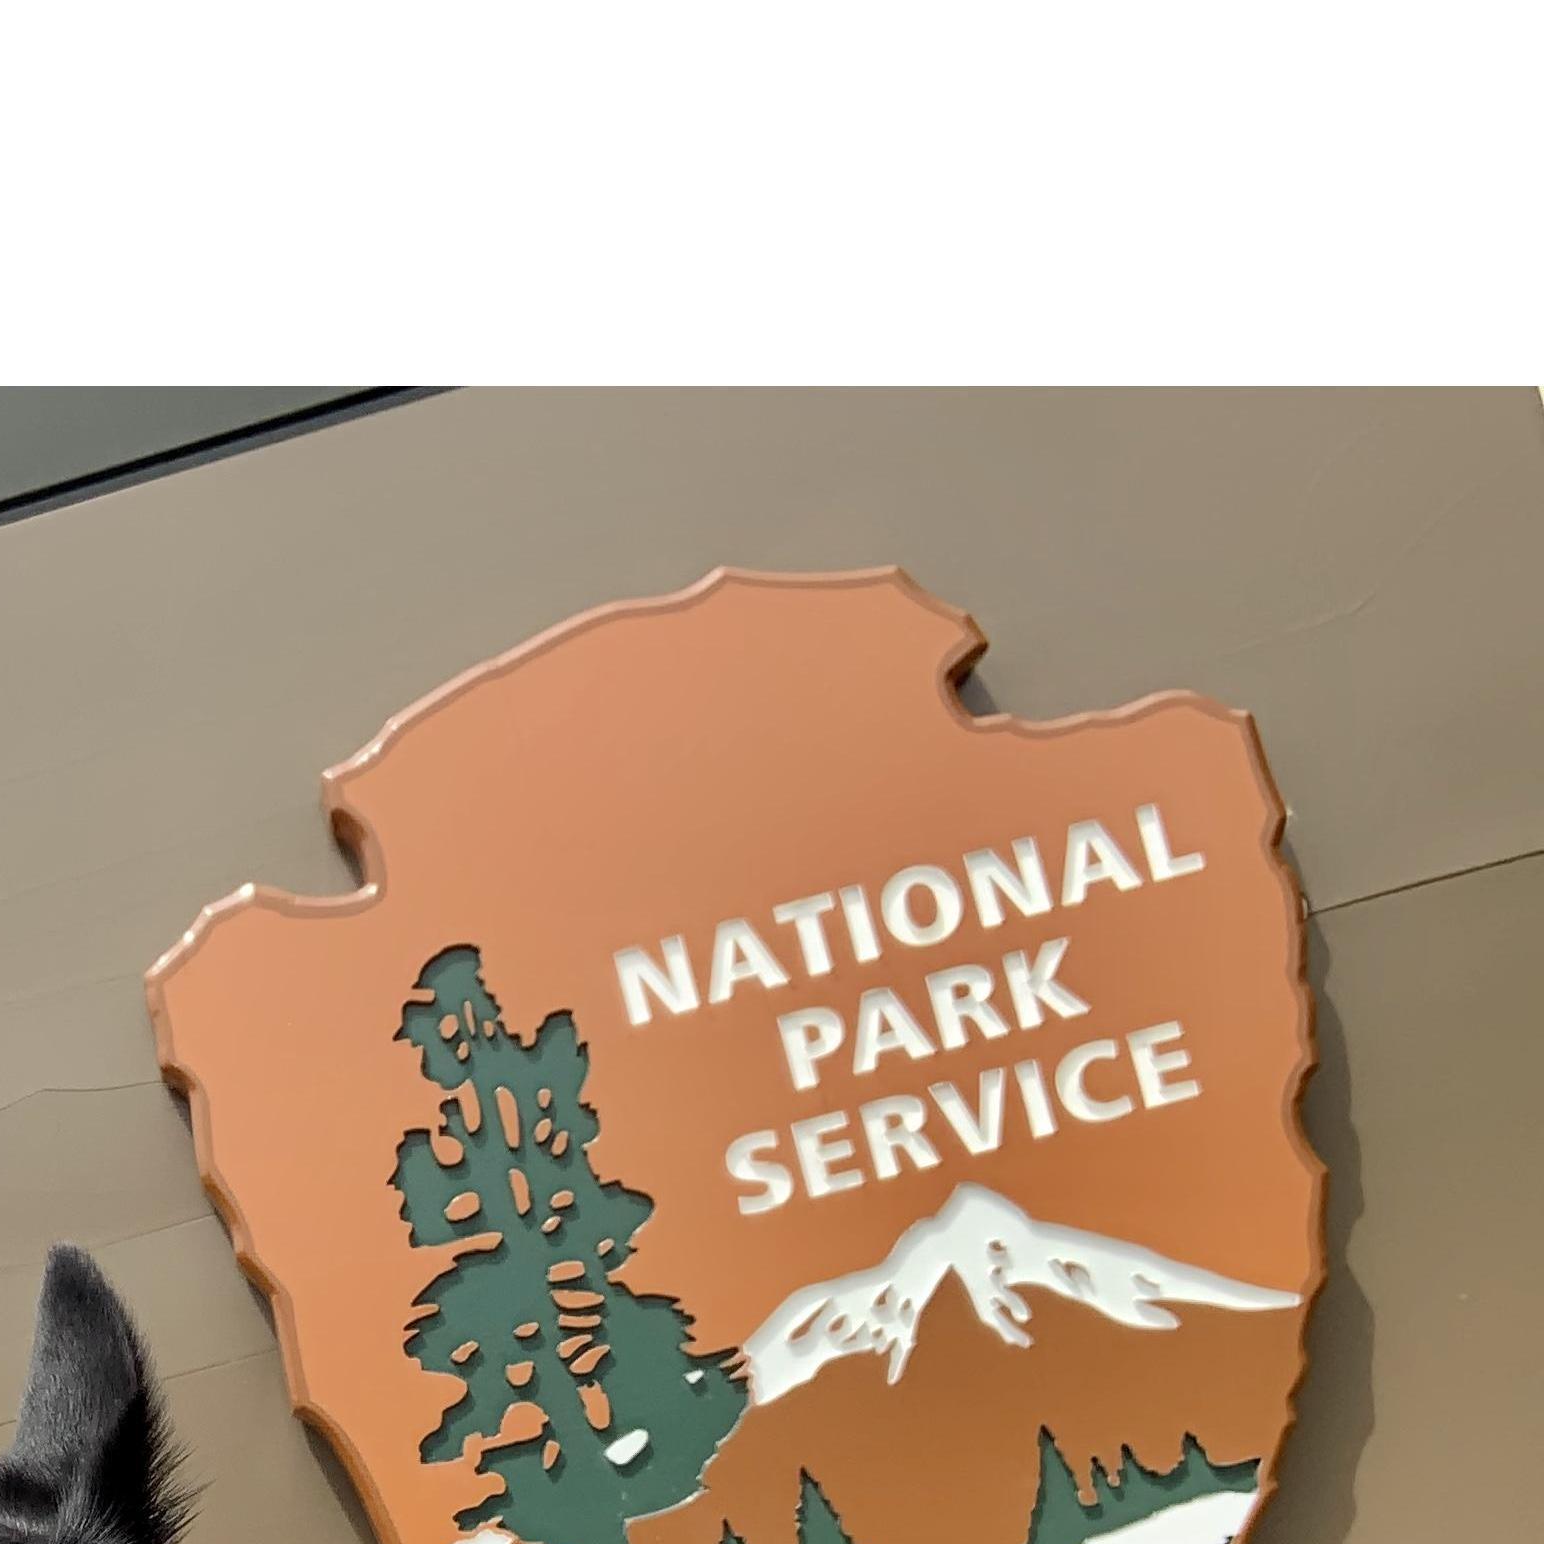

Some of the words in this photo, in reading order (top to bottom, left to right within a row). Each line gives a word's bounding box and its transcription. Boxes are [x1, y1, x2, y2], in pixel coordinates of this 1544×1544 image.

[613, 803, 1205, 1026] NATIONAL
[776, 937, 1091, 1092] PARK
[725, 1020, 1202, 1215] SERVICE
